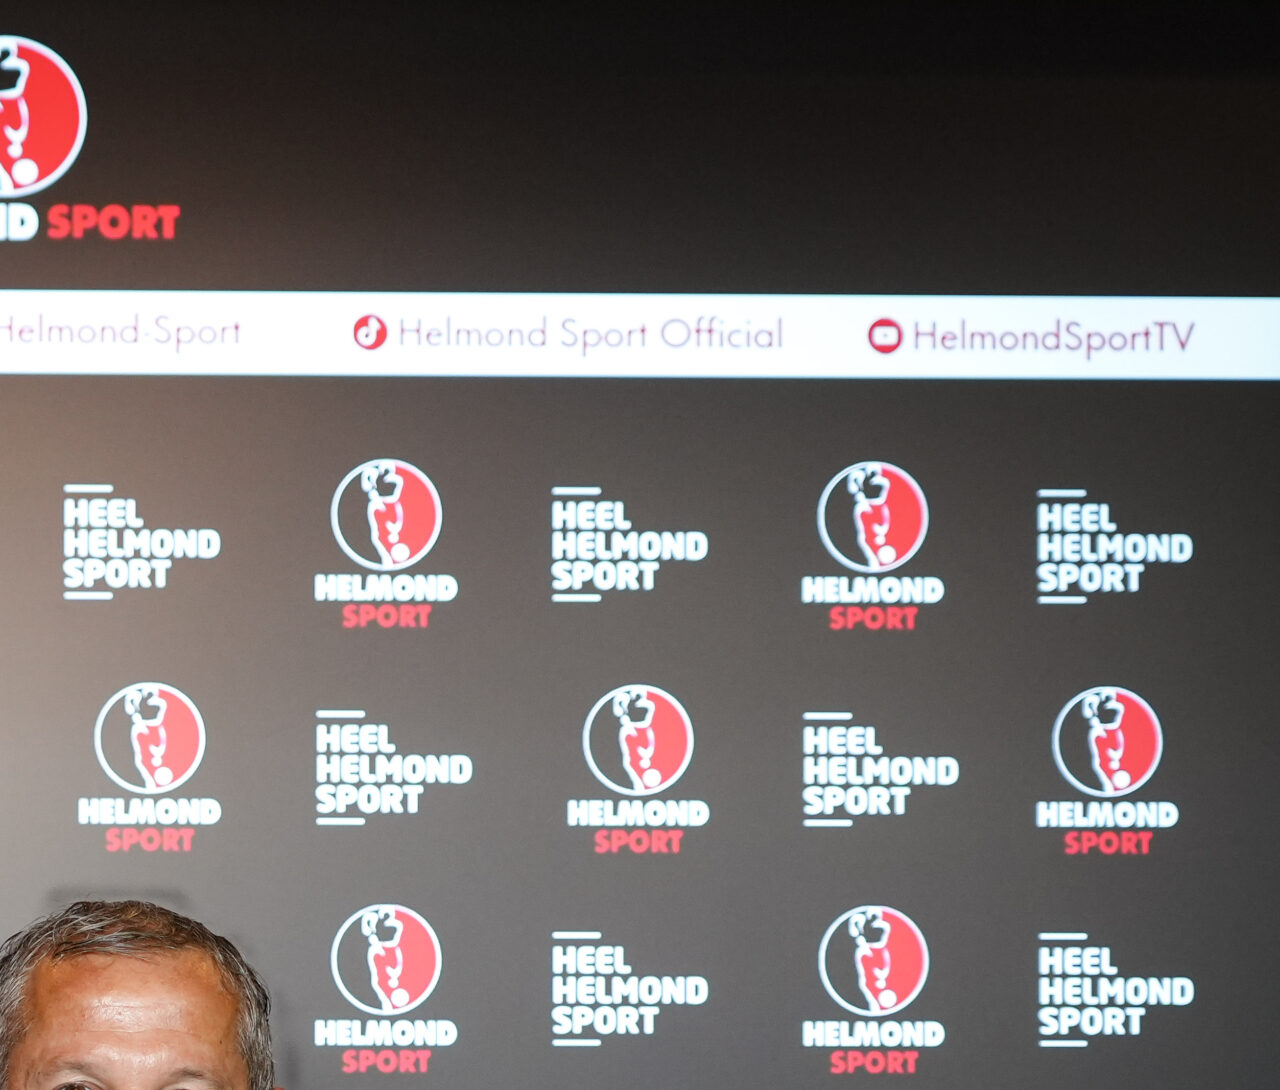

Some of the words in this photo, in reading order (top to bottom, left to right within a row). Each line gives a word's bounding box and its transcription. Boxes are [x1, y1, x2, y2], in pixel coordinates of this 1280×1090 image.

[46, 203, 182, 241] SPORT
[400, 316, 548, 348] Helmond
[561, 318, 648, 357] Sport
[661, 316, 784, 349] Official
[914, 317, 1197, 361] HelmondSportTV
[63, 498, 145, 529] HEEL
[551, 500, 632, 531] HEEL
[1038, 503, 1117, 532] HEEL
[62, 528, 221, 559] HELMOND
[551, 530, 709, 561] HELMOND
[1038, 533, 1193, 563] HELMOND
[62, 558, 173, 589] SPORT
[314, 573, 459, 602] HELMOND
[550, 560, 660, 591] SPORT
[1037, 562, 1145, 592] SPORT
[801, 576, 945, 604] HELMOND
[342, 603, 433, 629] SPORT
[829, 605, 919, 631] SPORT
[315, 723, 397, 754] HEEL
[803, 726, 884, 756] HEEL
[315, 753, 473, 785] HELMOND
[803, 756, 960, 786] HELMOND
[77, 797, 222, 826] HELMOND
[314, 783, 425, 814] SPORT
[566, 799, 710, 827] HELMOND
[802, 785, 911, 816] SPORT
[1036, 801, 1179, 828] HELMOND
[106, 827, 196, 852] SPORT
[594, 828, 685, 854] SPORT
[1063, 830, 1154, 856] SPORT
[552, 945, 632, 975] HEEL
[1038, 946, 1118, 976] HEEL
[552, 975, 709, 1005] HELMOND
[1038, 976, 1195, 1006] HELMOND
[314, 1019, 458, 1047] HELMOND
[551, 1005, 660, 1035] SPORT
[802, 1020, 946, 1048] HELMOND
[1038, 1006, 1146, 1036] SPORT
[342, 1049, 433, 1074] SPORT
[830, 1049, 920, 1075] SPORT
